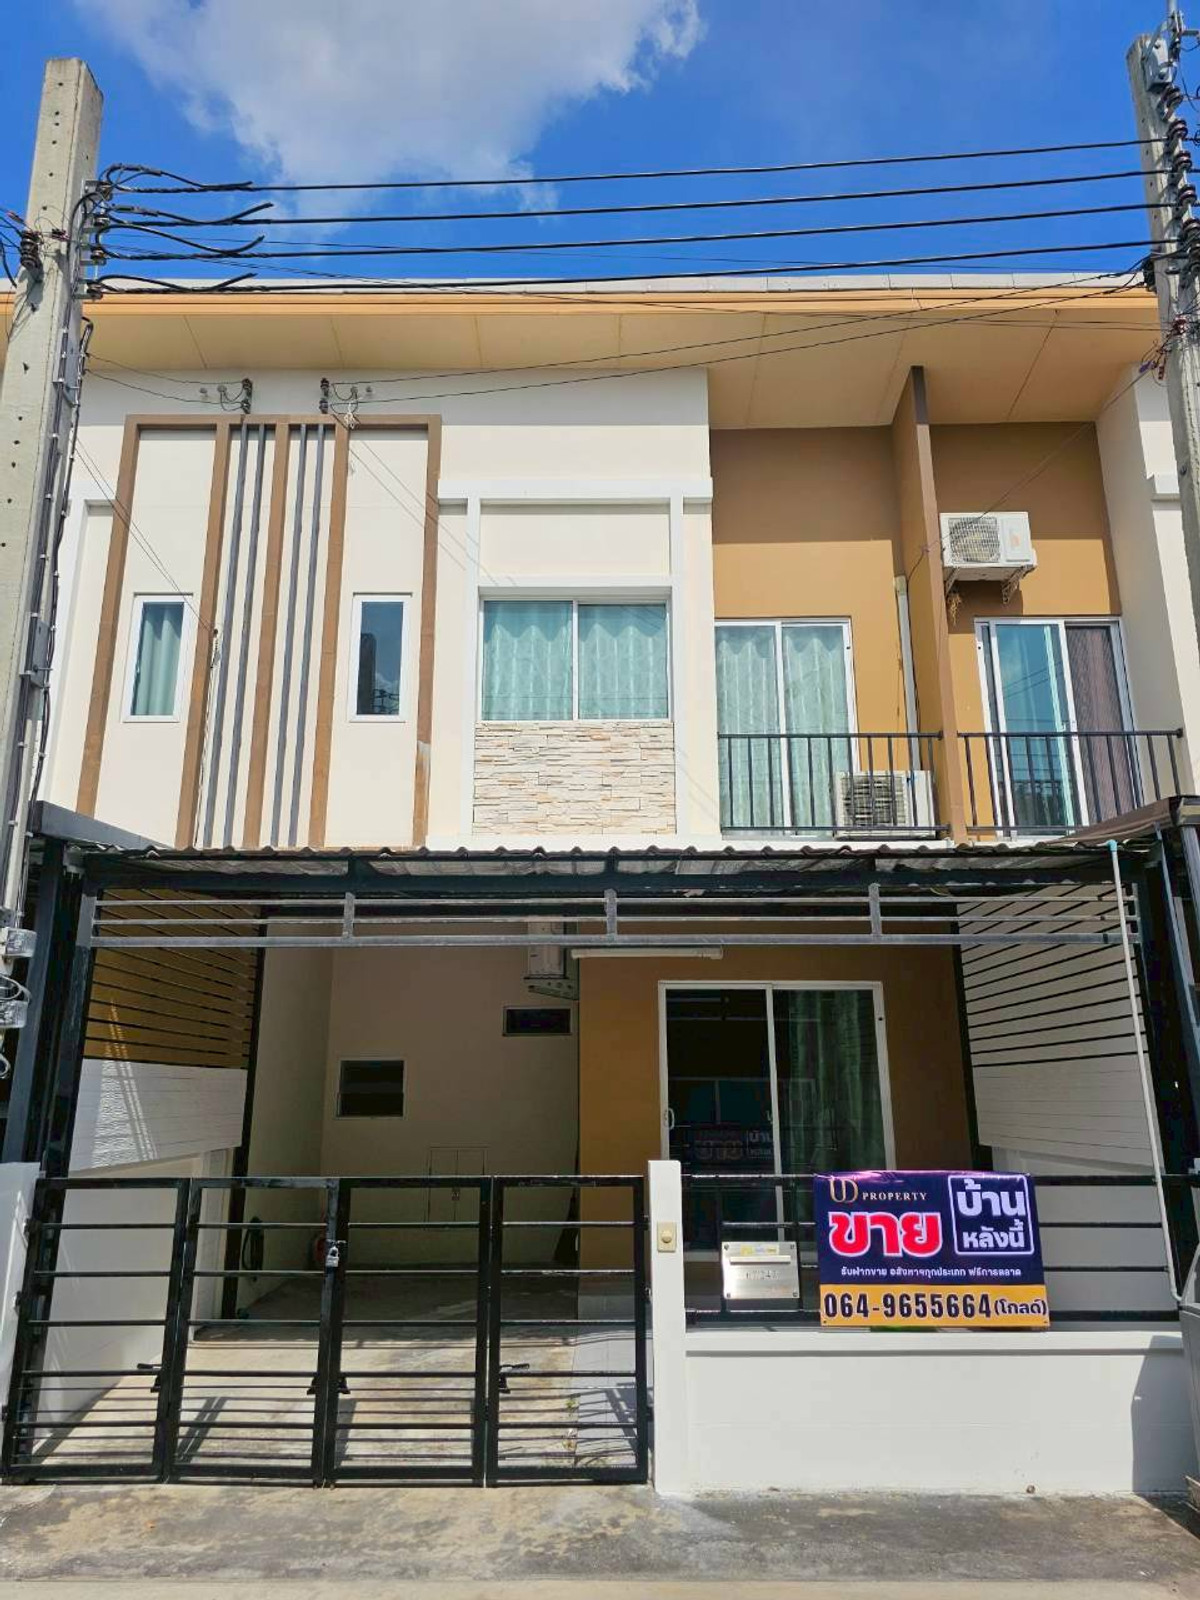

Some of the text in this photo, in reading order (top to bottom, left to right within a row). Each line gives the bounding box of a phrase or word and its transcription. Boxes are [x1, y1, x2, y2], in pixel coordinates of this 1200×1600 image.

[862, 1191, 928, 1202] PROPERTY
[955, 1179, 1027, 1217] บ้าน
[828, 1211, 943, 1257] ขาย
[962, 1219, 1026, 1249] หลังนี้
[823, 1292, 992, 1319] 064-9655664
